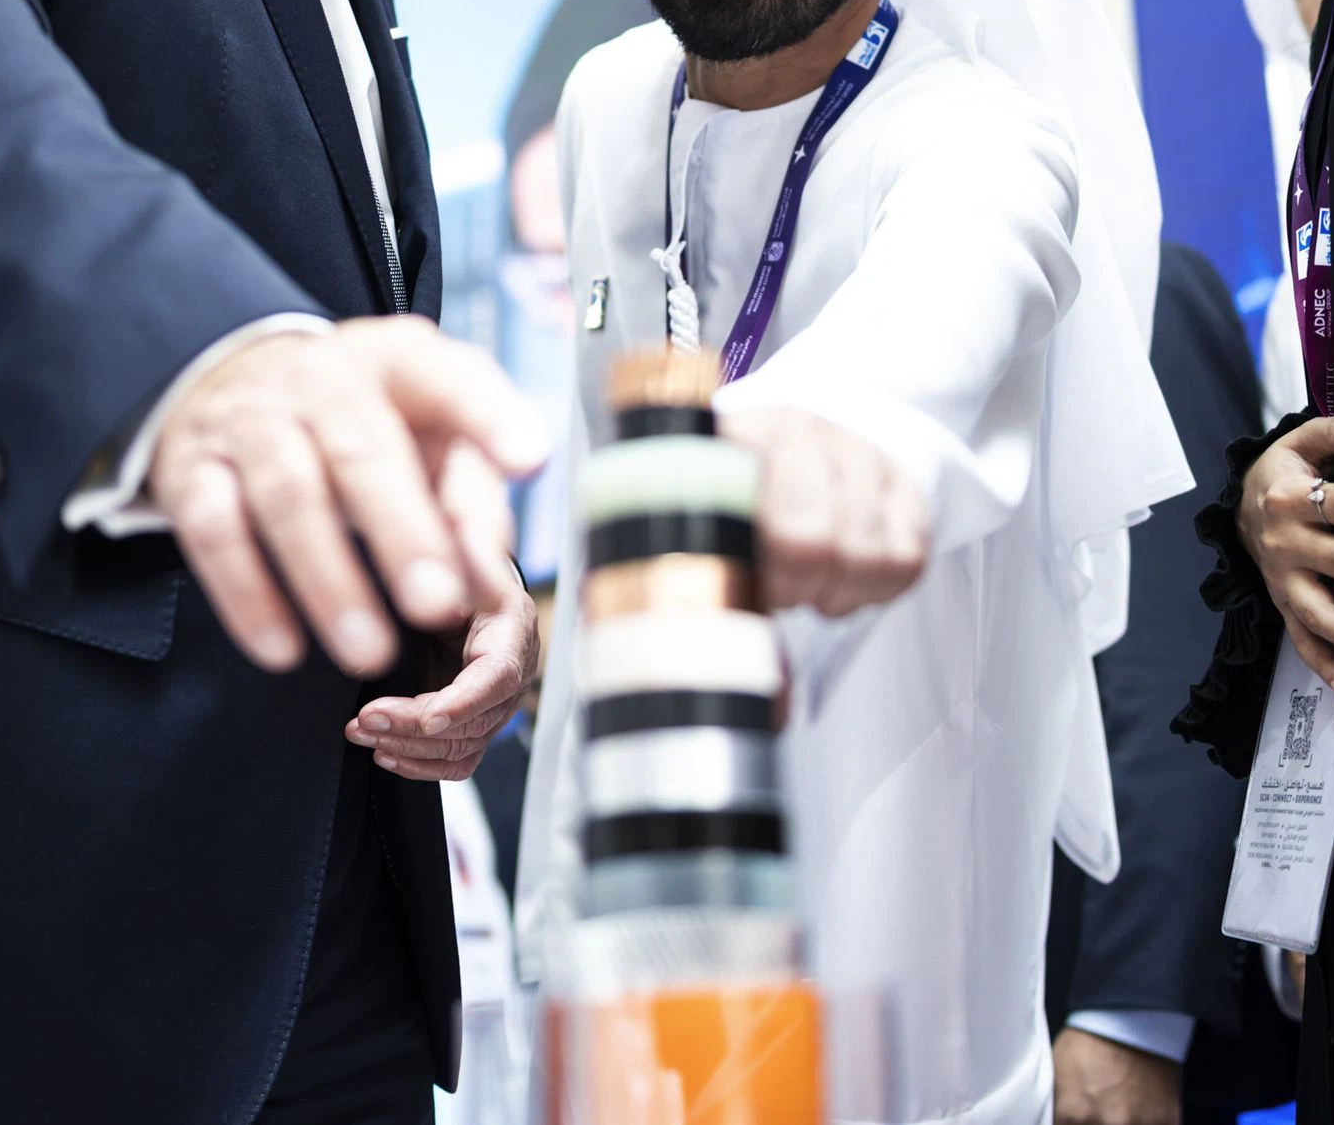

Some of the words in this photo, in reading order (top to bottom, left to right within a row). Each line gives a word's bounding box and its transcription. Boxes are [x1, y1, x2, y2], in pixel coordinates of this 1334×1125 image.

[1314, 289, 1325, 337] ADNEC
[1272, 794, 1292, 802] CONNECT
[1295, 795, 1322, 804] EXPERIENCE
